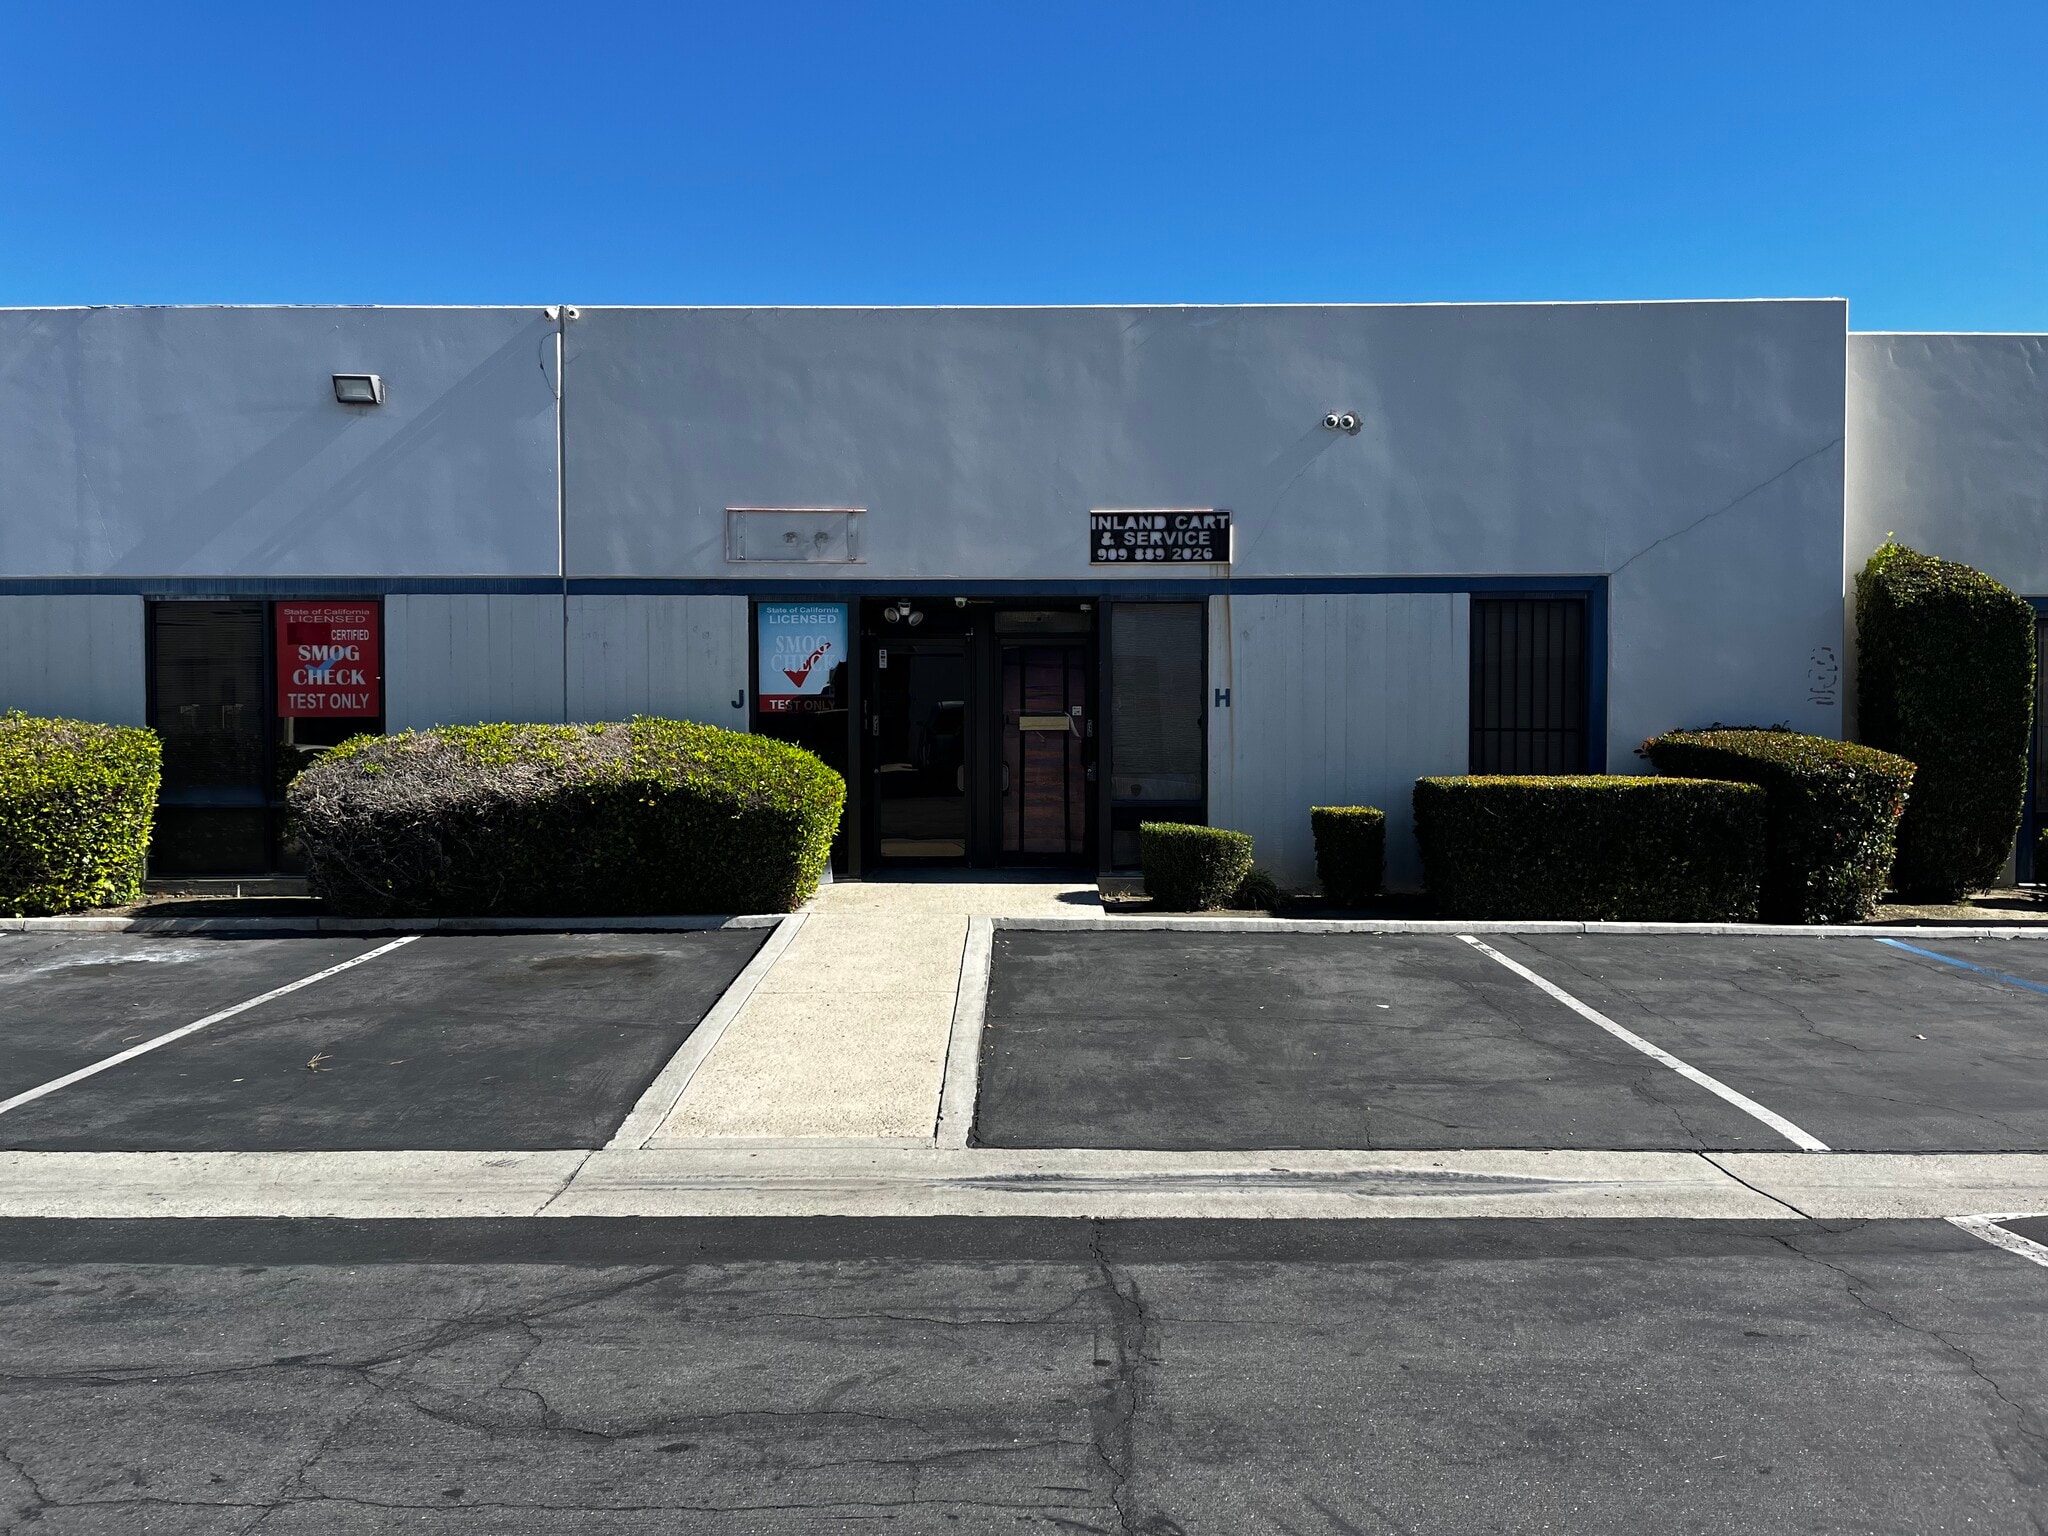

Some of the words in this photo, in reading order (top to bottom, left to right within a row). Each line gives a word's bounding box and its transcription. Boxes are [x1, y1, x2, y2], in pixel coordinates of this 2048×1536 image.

[1091, 516, 1166, 530] INLAND
[1174, 515, 1229, 529] CART
[1101, 532, 1114, 545] &
[1124, 531, 1210, 545] SERVICE
[290, 615, 366, 623] LICENSED
[769, 615, 836, 624] LICENSED
[331, 629, 370, 641] CERTIFIED
[298, 644, 360, 661] SMOG
[292, 668, 366, 685] CHECK
[287, 693, 326, 709] TEST
[329, 693, 370, 709] ONLY
[731, 689, 745, 709] J
[769, 699, 800, 710] TEST
[803, 700, 836, 710] ONLY
[1214, 688, 1231, 708] H
